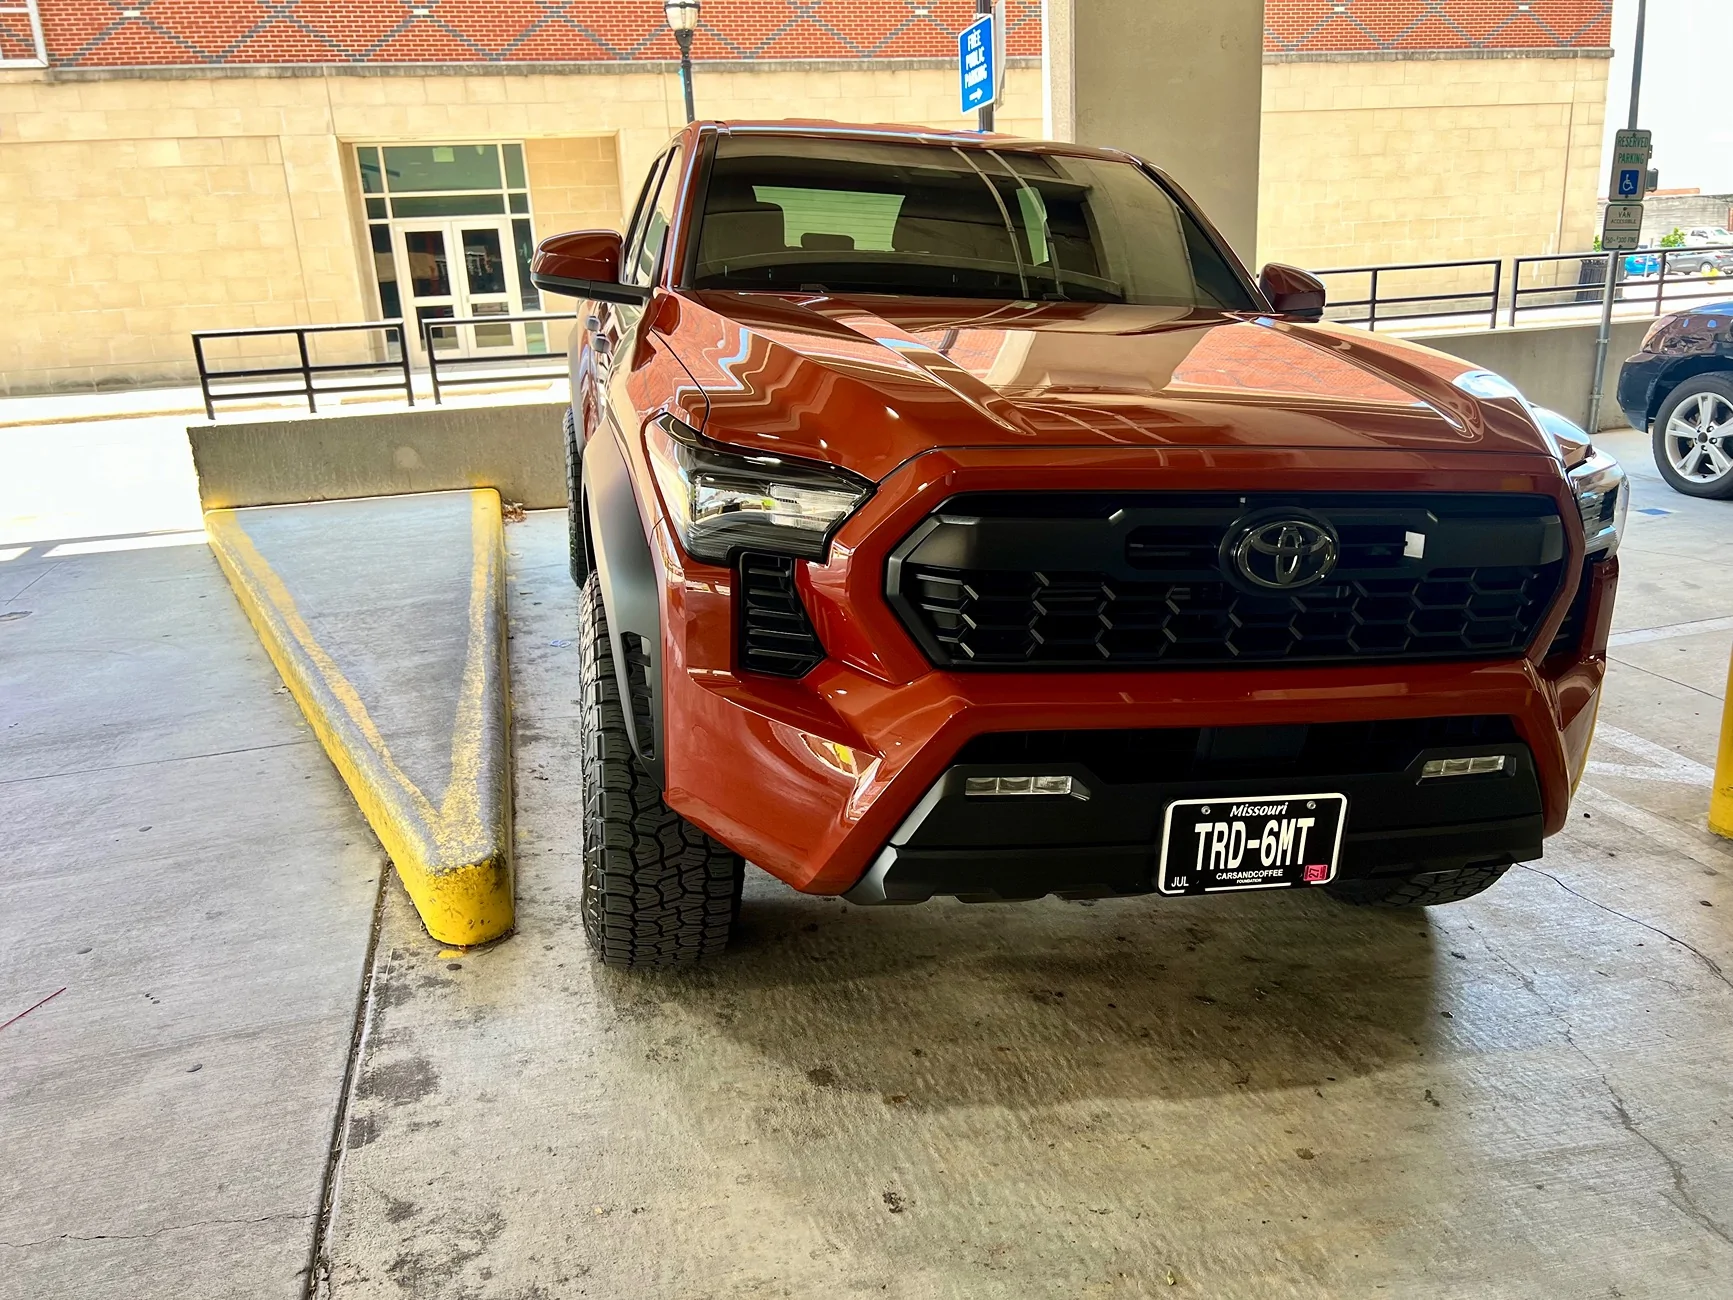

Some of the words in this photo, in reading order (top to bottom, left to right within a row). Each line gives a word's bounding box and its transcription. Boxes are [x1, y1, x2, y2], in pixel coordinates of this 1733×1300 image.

[967, 29, 982, 51] FREE
[965, 46, 985, 70] PUBLIC
[964, 63, 988, 89] PARKING
[1617, 136, 1649, 148] RESERVED
[1618, 152, 1644, 164] PARKING
[1229, 802, 1289, 818] Missouri
[1194, 817, 1316, 871] TRD-6MT
[1216, 869, 1284, 880] CARSANDCOFFEE
[1308, 867, 1320, 878] 27
[1171, 876, 1190, 887] JUL
